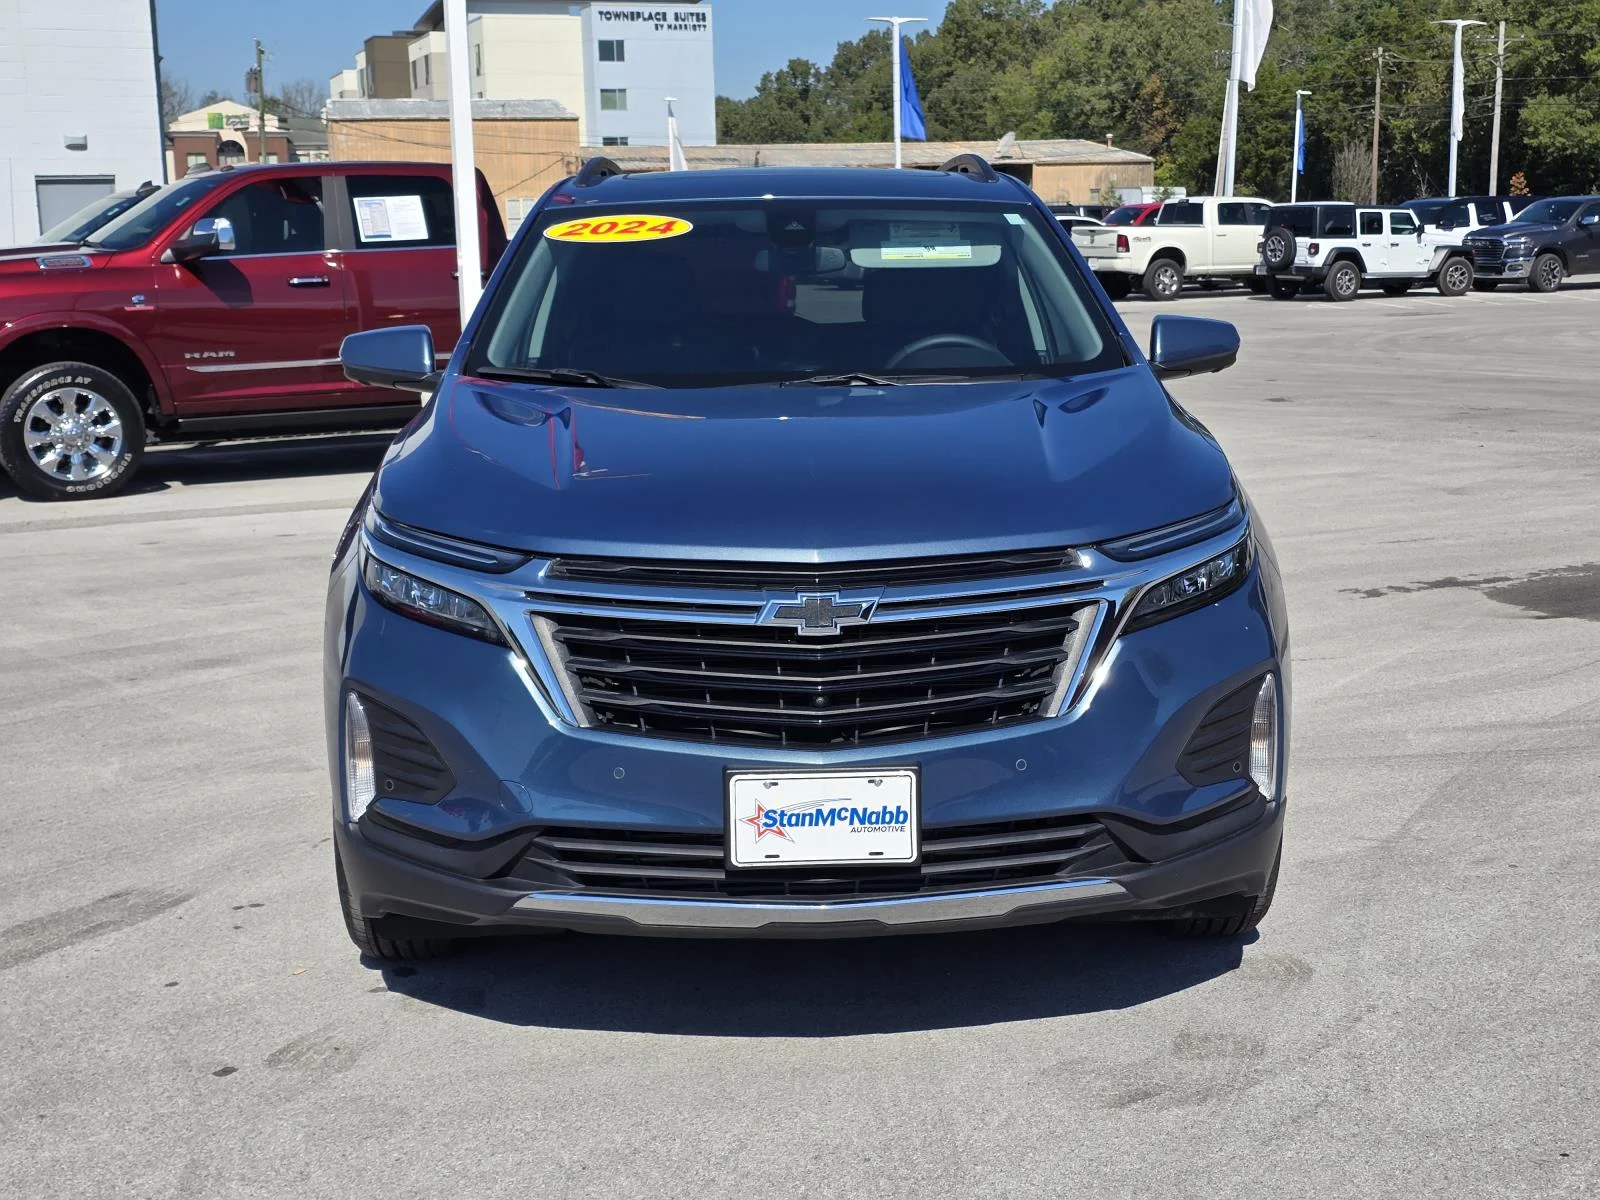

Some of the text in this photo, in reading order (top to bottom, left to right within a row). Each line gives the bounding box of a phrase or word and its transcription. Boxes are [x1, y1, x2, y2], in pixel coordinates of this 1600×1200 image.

[598, 10, 706, 22] TOWNEPLACE SUITES
[654, 23, 707, 32] BY MARRIOTT
[558, 220, 678, 238] 2024
[762, 805, 909, 829] StanMcNabb
[850, 825, 906, 834] AUTOMOTIVE
